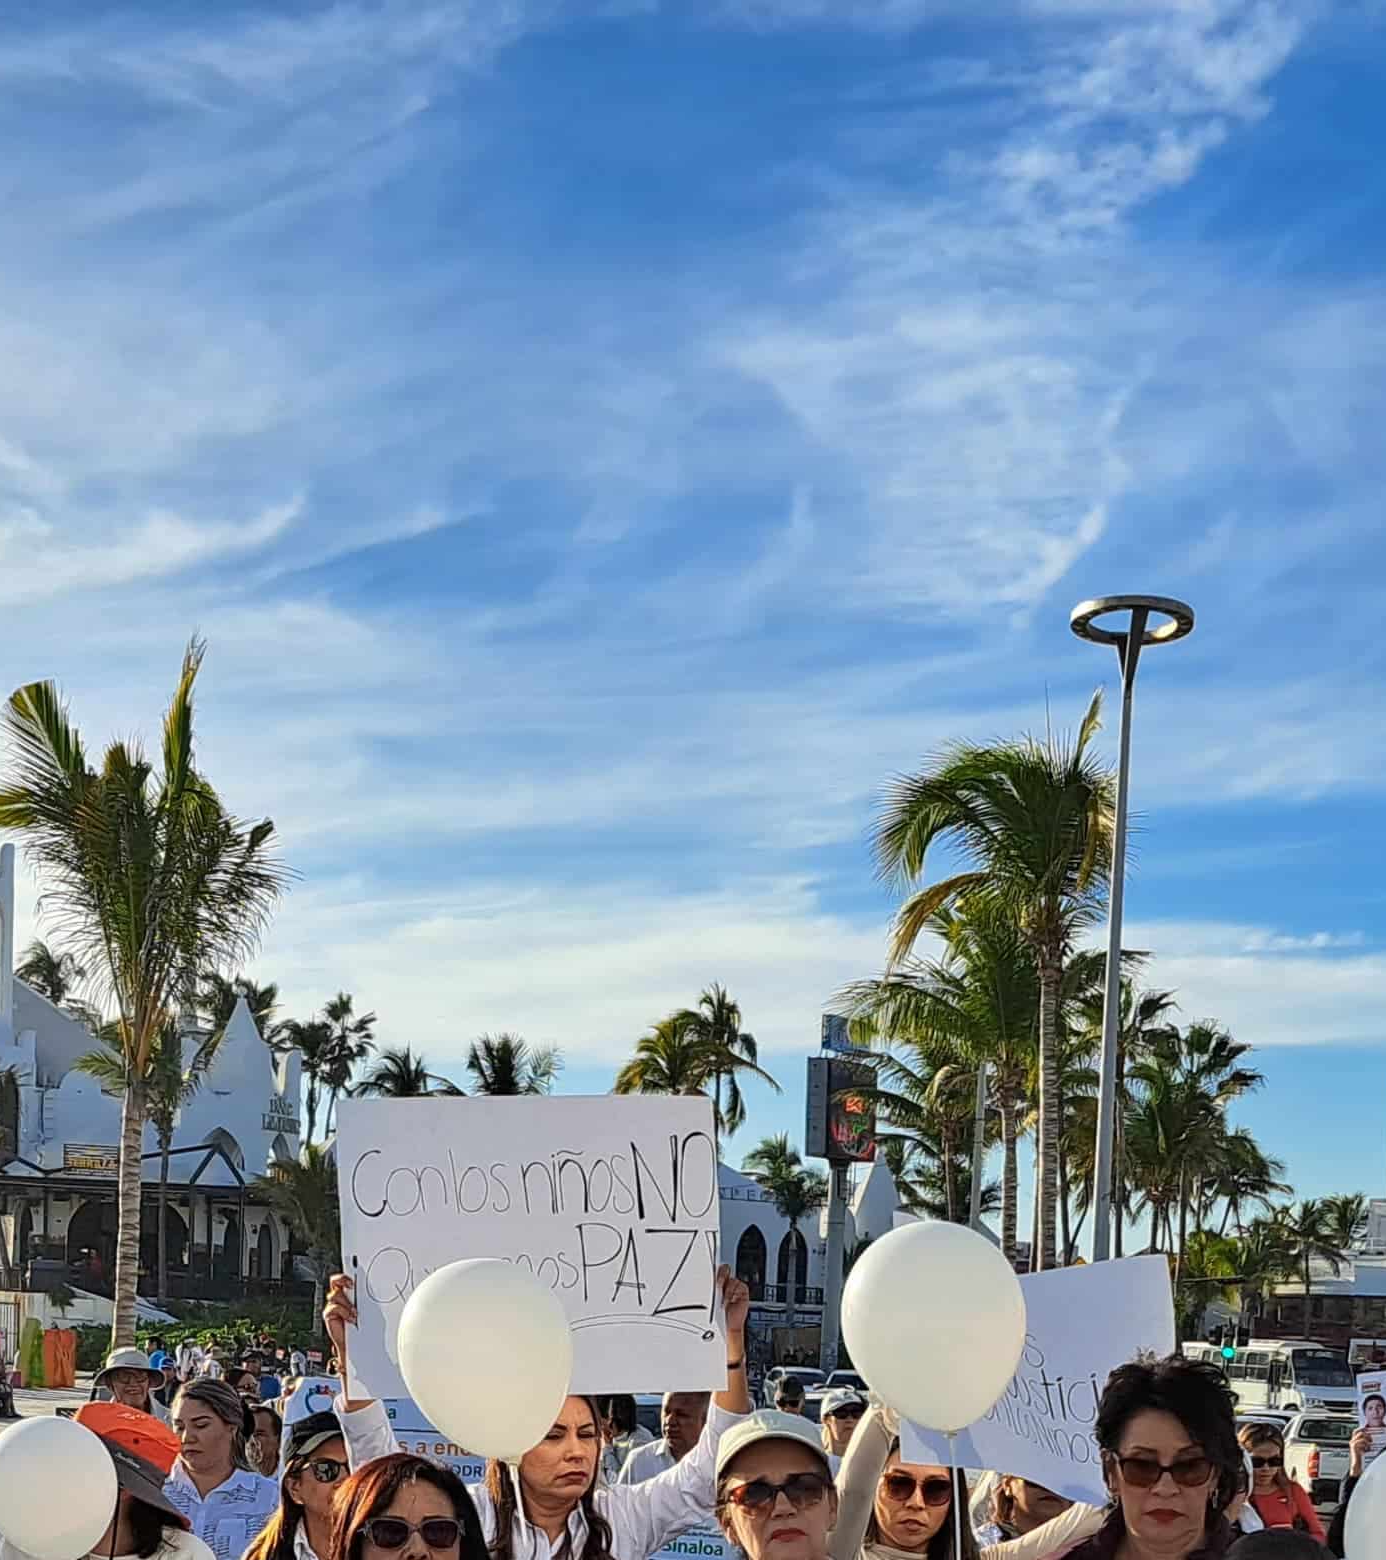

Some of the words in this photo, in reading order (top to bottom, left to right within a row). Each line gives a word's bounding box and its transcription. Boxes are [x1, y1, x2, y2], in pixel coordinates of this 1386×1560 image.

[448, 1148, 511, 1215] los
[519, 1150, 634, 1216] niños
[630, 1131, 715, 1224] NO
